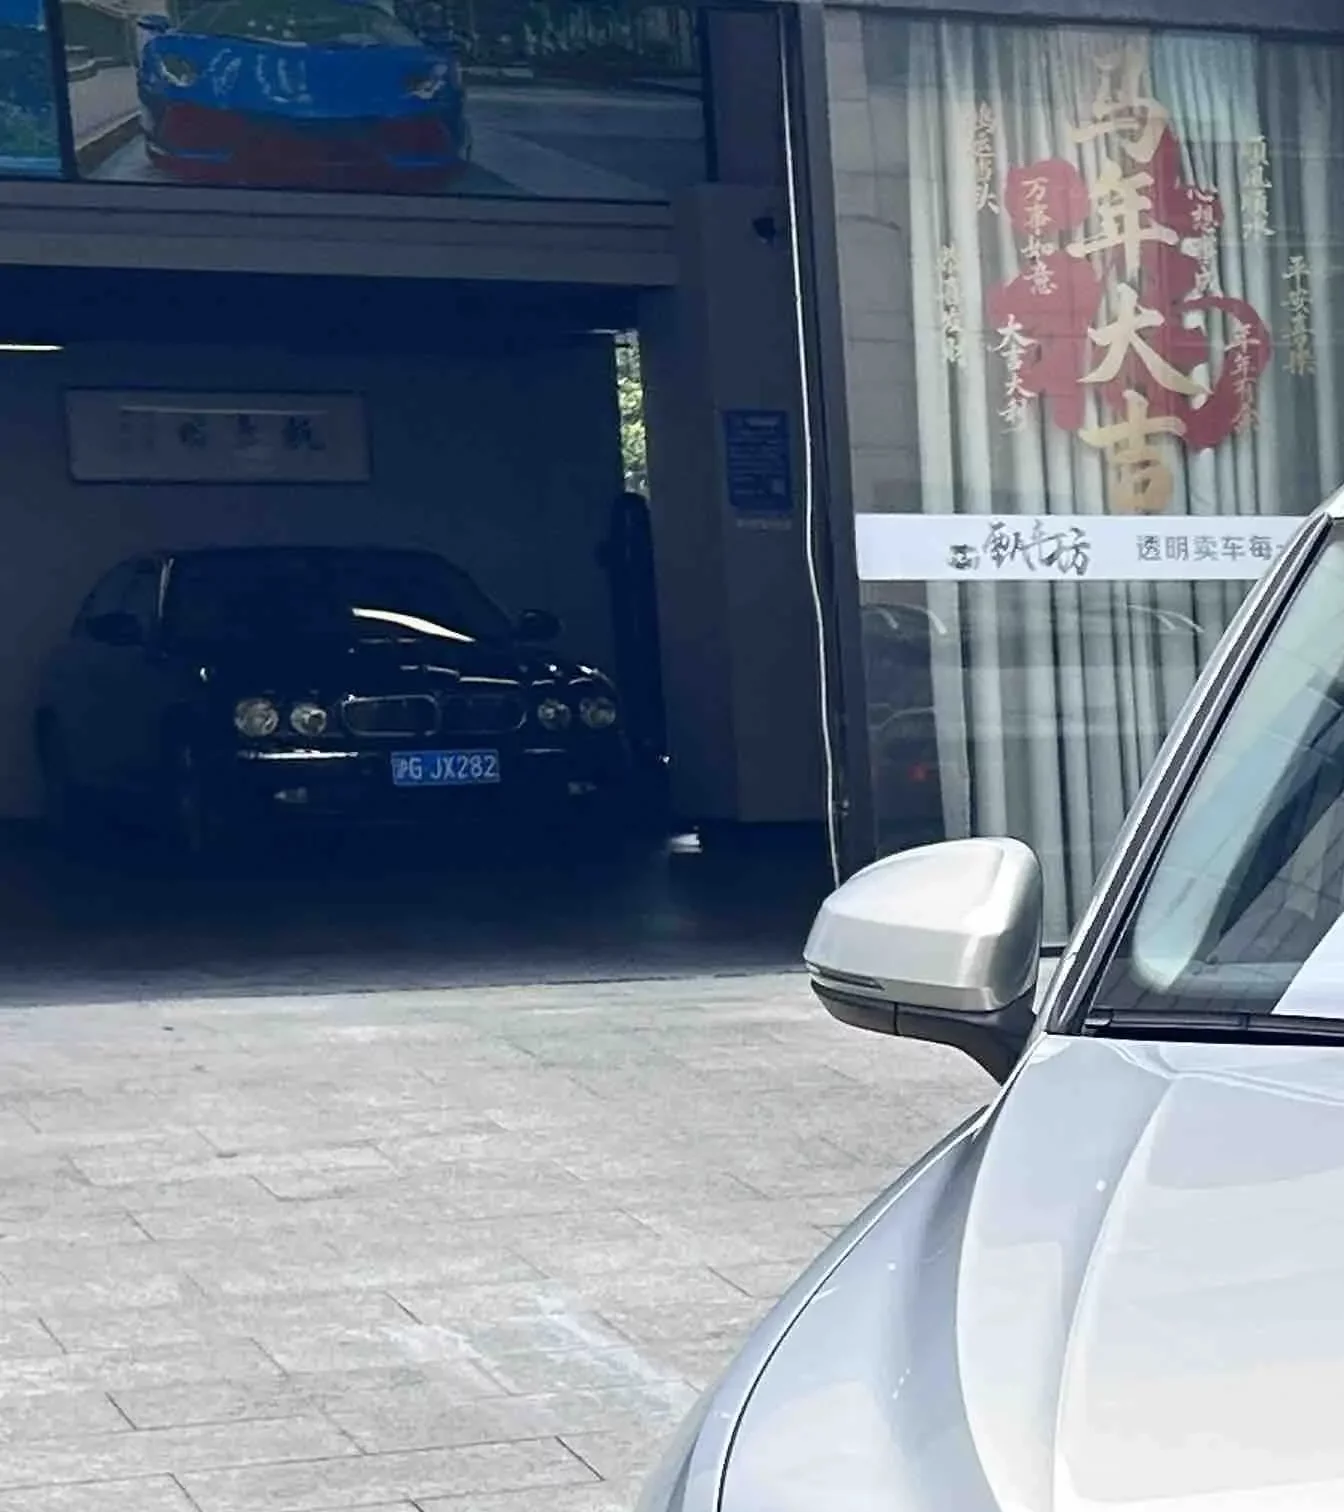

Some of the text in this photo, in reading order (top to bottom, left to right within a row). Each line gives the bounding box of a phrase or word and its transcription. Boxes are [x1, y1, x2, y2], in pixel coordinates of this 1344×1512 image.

[1020, 176, 1059, 296] 万事如意
[1066, 48, 1212, 511] 马年大吉
[1186, 186, 1222, 301] 心想事成
[989, 313, 1039, 433] 大吉大利
[1135, 534, 1284, 562] 透明卖车每
